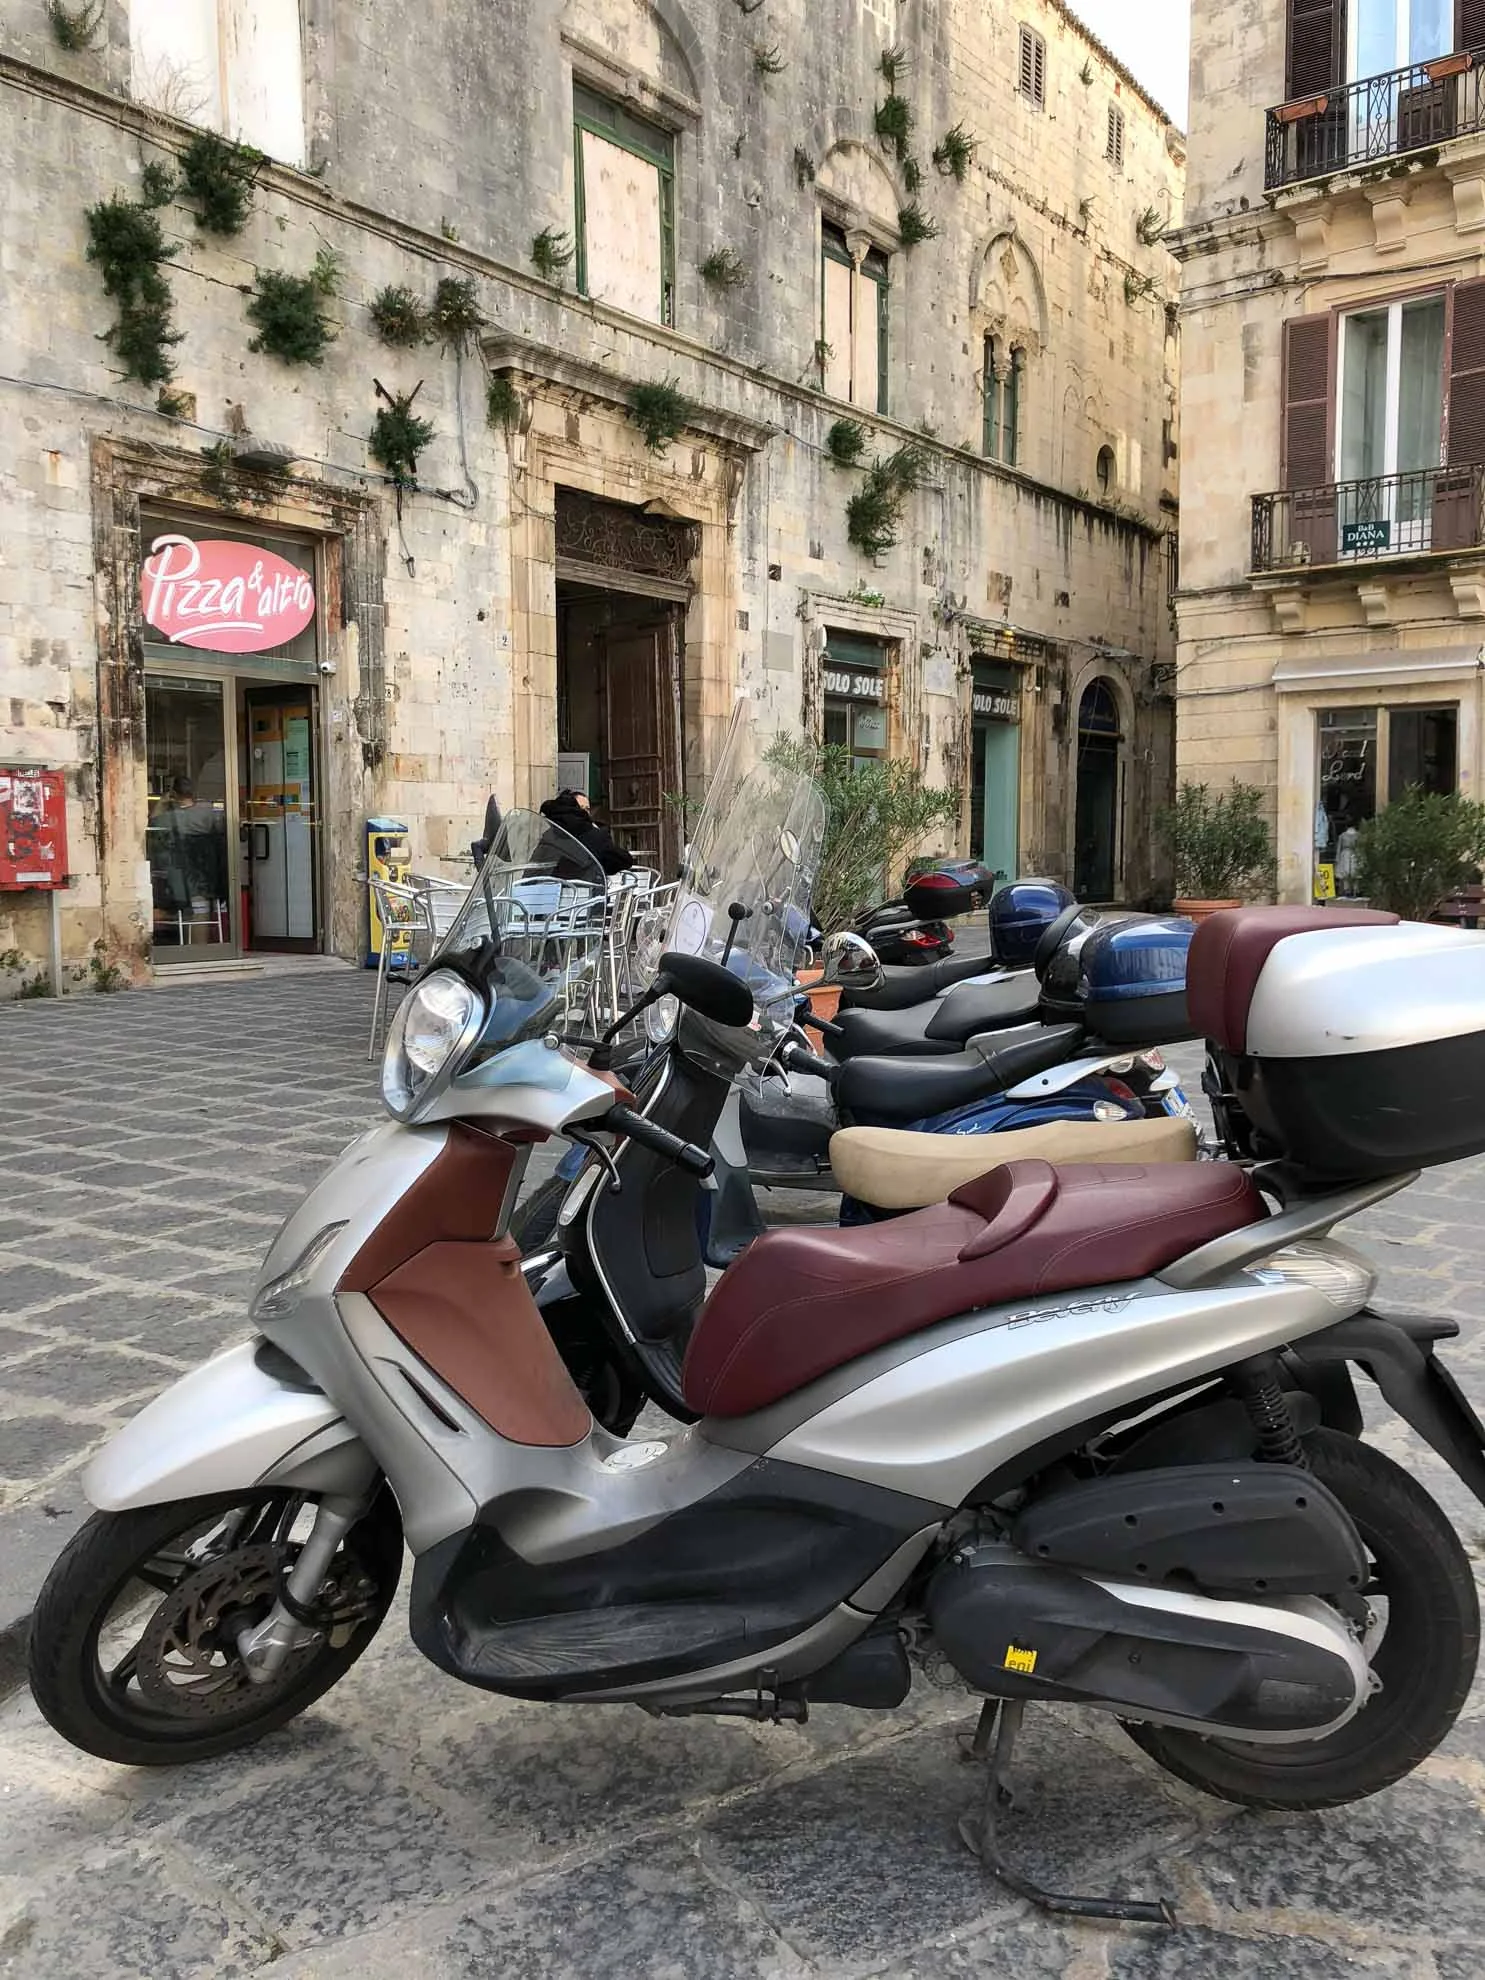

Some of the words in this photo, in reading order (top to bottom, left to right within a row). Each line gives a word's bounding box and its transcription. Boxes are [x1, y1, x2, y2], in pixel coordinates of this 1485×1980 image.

[1347, 530, 1384, 541] DIANA
[144, 534, 246, 624] Pizza
[247, 560, 264, 592] &
[258, 572, 313, 616] altro
[853, 676, 884, 696] SOLE
[973, 694, 992, 712] OLO
[992, 697, 1017, 715] SOLE
